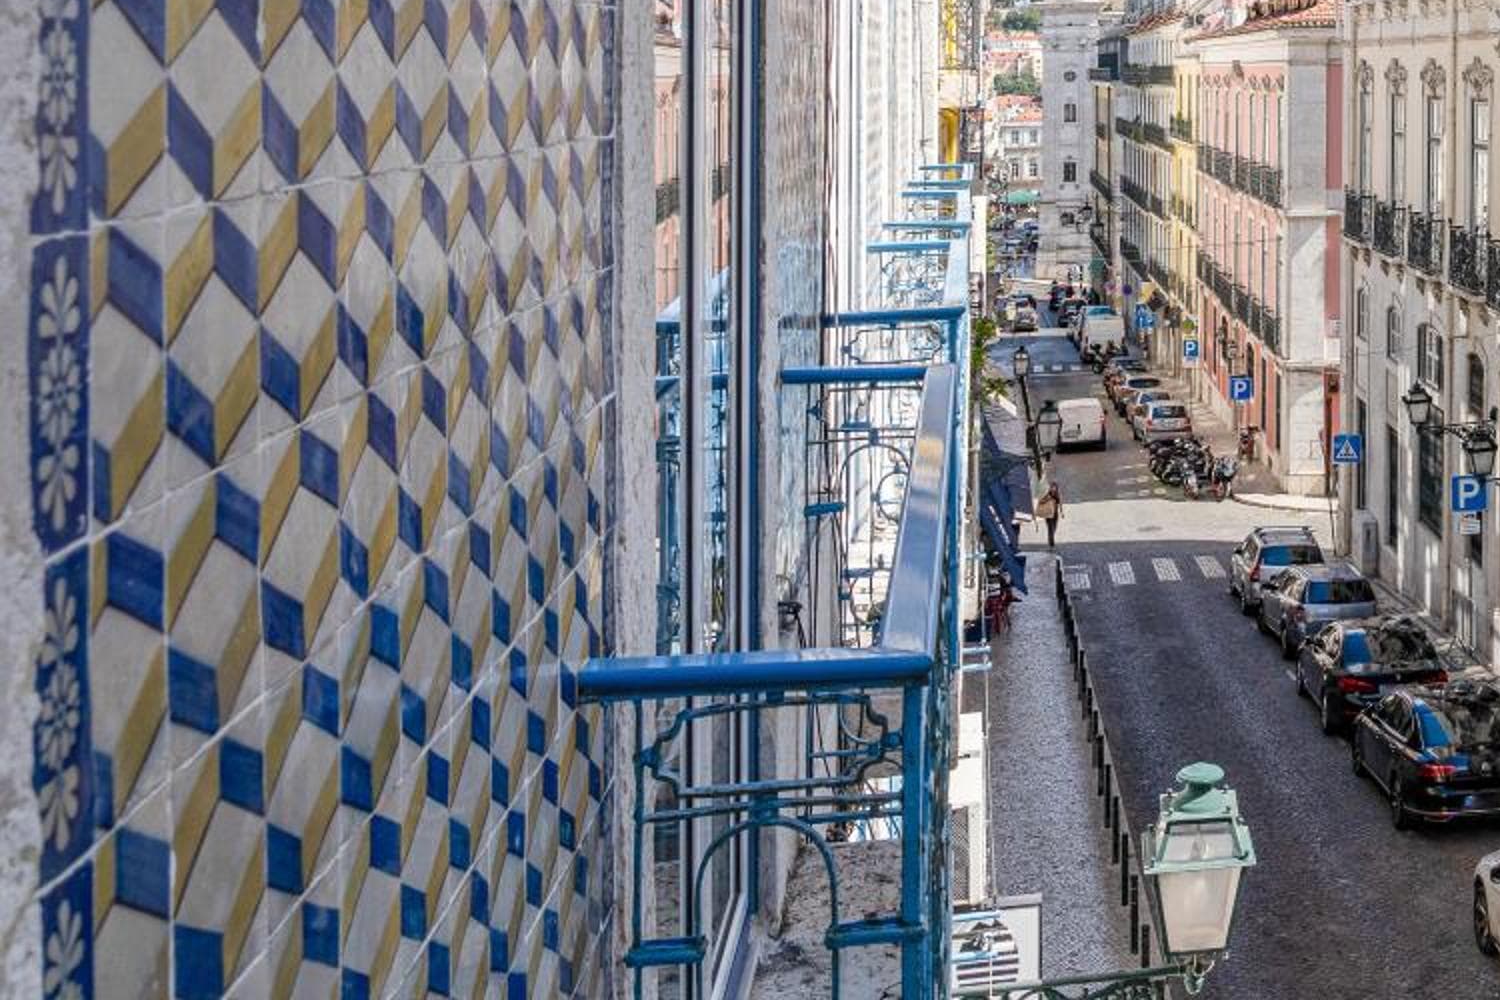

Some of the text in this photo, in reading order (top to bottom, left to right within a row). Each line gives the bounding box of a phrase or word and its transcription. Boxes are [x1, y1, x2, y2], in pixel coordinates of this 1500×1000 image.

[1185, 341, 1196, 355] P
[1234, 381, 1247, 399] P
[1459, 478, 1480, 509] P
